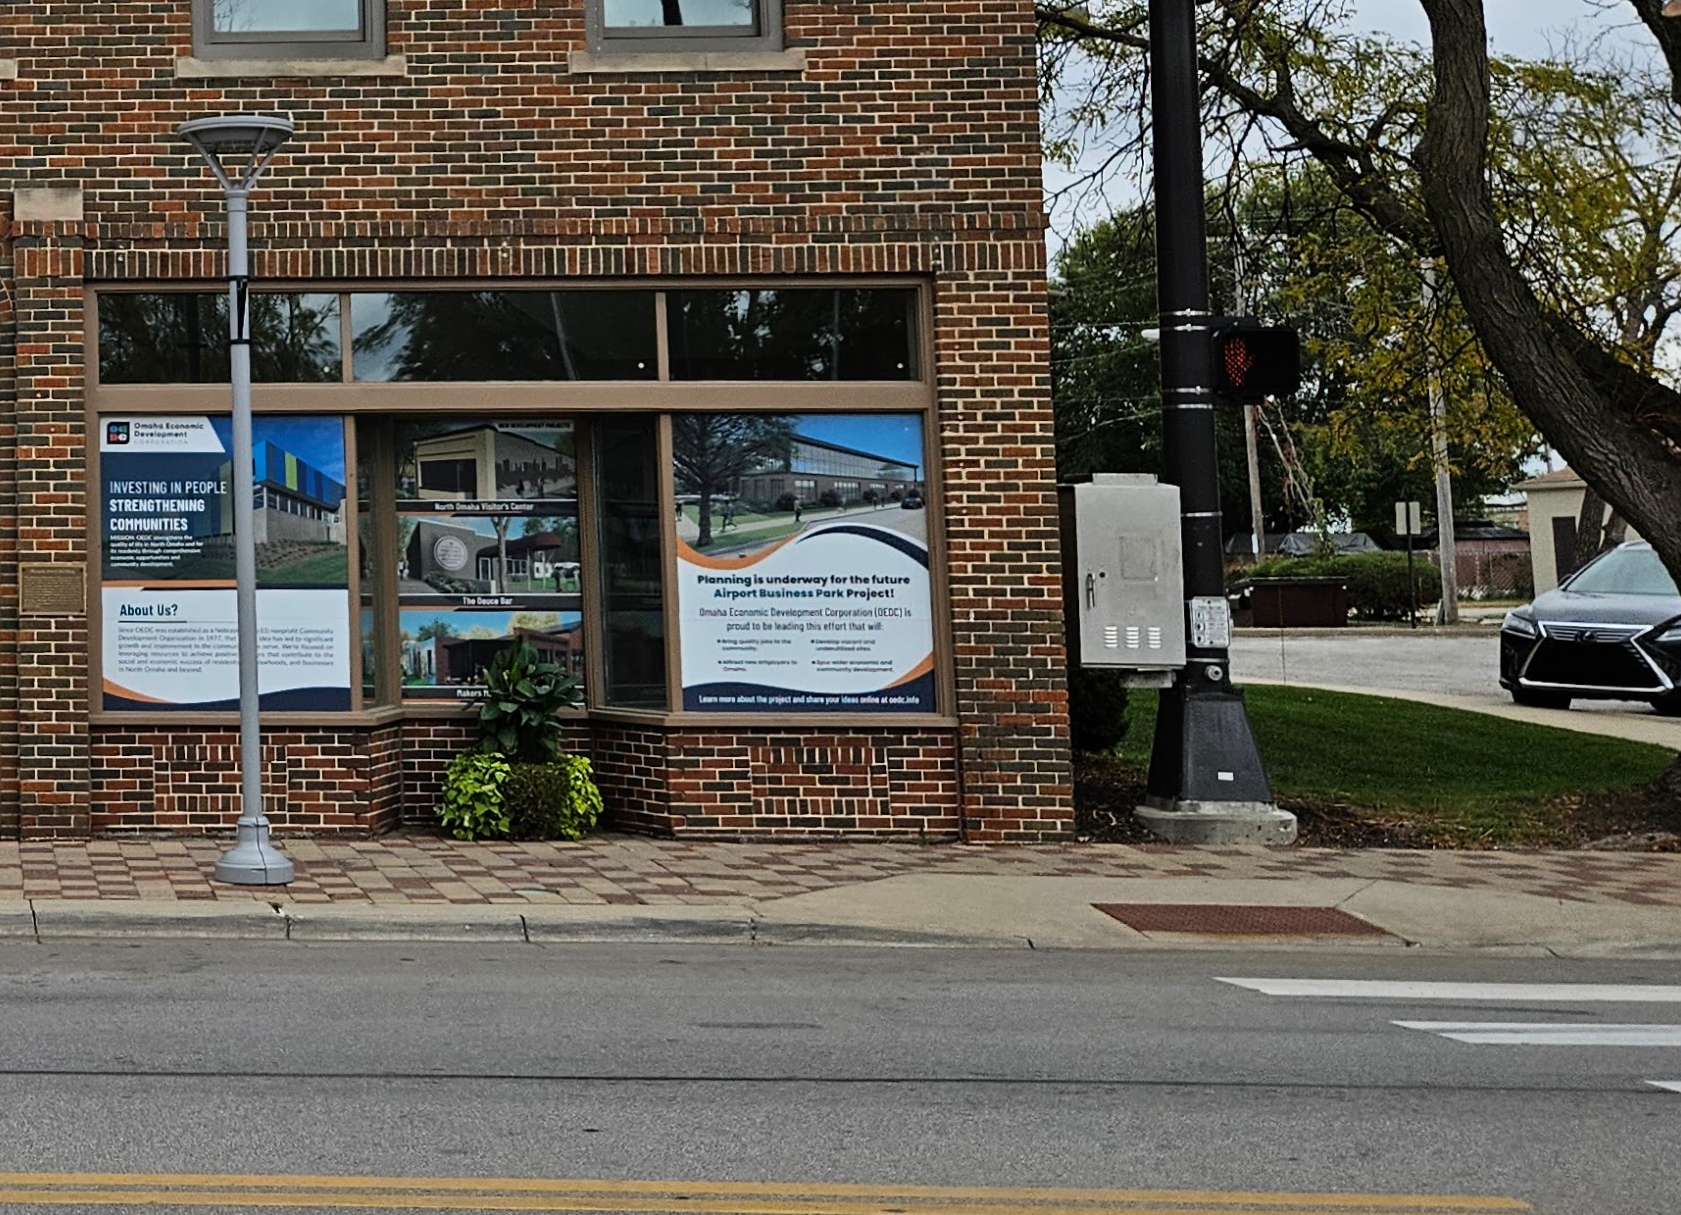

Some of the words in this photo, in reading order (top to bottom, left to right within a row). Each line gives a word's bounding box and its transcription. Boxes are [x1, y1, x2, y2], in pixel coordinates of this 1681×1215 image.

[134, 422, 164, 430] Omaha
[166, 422, 204, 430] Economic
[134, 430, 187, 438] Development
[109, 481, 167, 494] INVESTING
[170, 481, 182, 494] IN
[185, 481, 227, 494] PEOPLE
[109, 499, 205, 512] STRENGTHENING
[434, 503, 455, 511] North
[456, 503, 480, 511] Omaha
[481, 503, 510, 511] Visitor's
[510, 503, 534, 511] Center
[110, 518, 188, 531] COMMUNITIES
[697, 574, 752, 587] Planning
[754, 574, 764, 584] is
[766, 575, 828, 587] underway
[830, 575, 847, 584] for
[850, 575, 870, 584] the
[871, 575, 911, 584] future
[714, 587, 757, 601] Airport
[759, 588, 814, 598] Business
[816, 589, 844, 598] Park
[846, 587, 894, 601] Project!
[463, 596, 476, 605] The
[500, 596, 513, 605] Bar
[120, 604, 154, 616] About
[157, 604, 178, 616] Us?
[699, 607, 727, 617] Omaha
[729, 607, 768, 617] Economic
[771, 607, 822, 618] Development
[825, 607, 873, 618] Corporation
[874, 607, 903, 617] (OEDC)
[904, 607, 912, 617] is
[727, 622, 750, 632] proud
[752, 622, 760, 631] to
[763, 622, 772, 631] be
[774, 622, 804, 632] leading
[806, 622, 821, 631] this
[823, 622, 847, 631] effort
[849, 622, 866, 631] that
[456, 689, 482, 697] Makers
[699, 695, 718, 703] Learn
[768, 696, 791, 704] project
[825, 696, 839, 704] your
[841, 695, 859, 704] ideas
[860, 696, 879, 704] online
[881, 696, 888, 704] at
[889, 696, 920, 704] oedc.info
